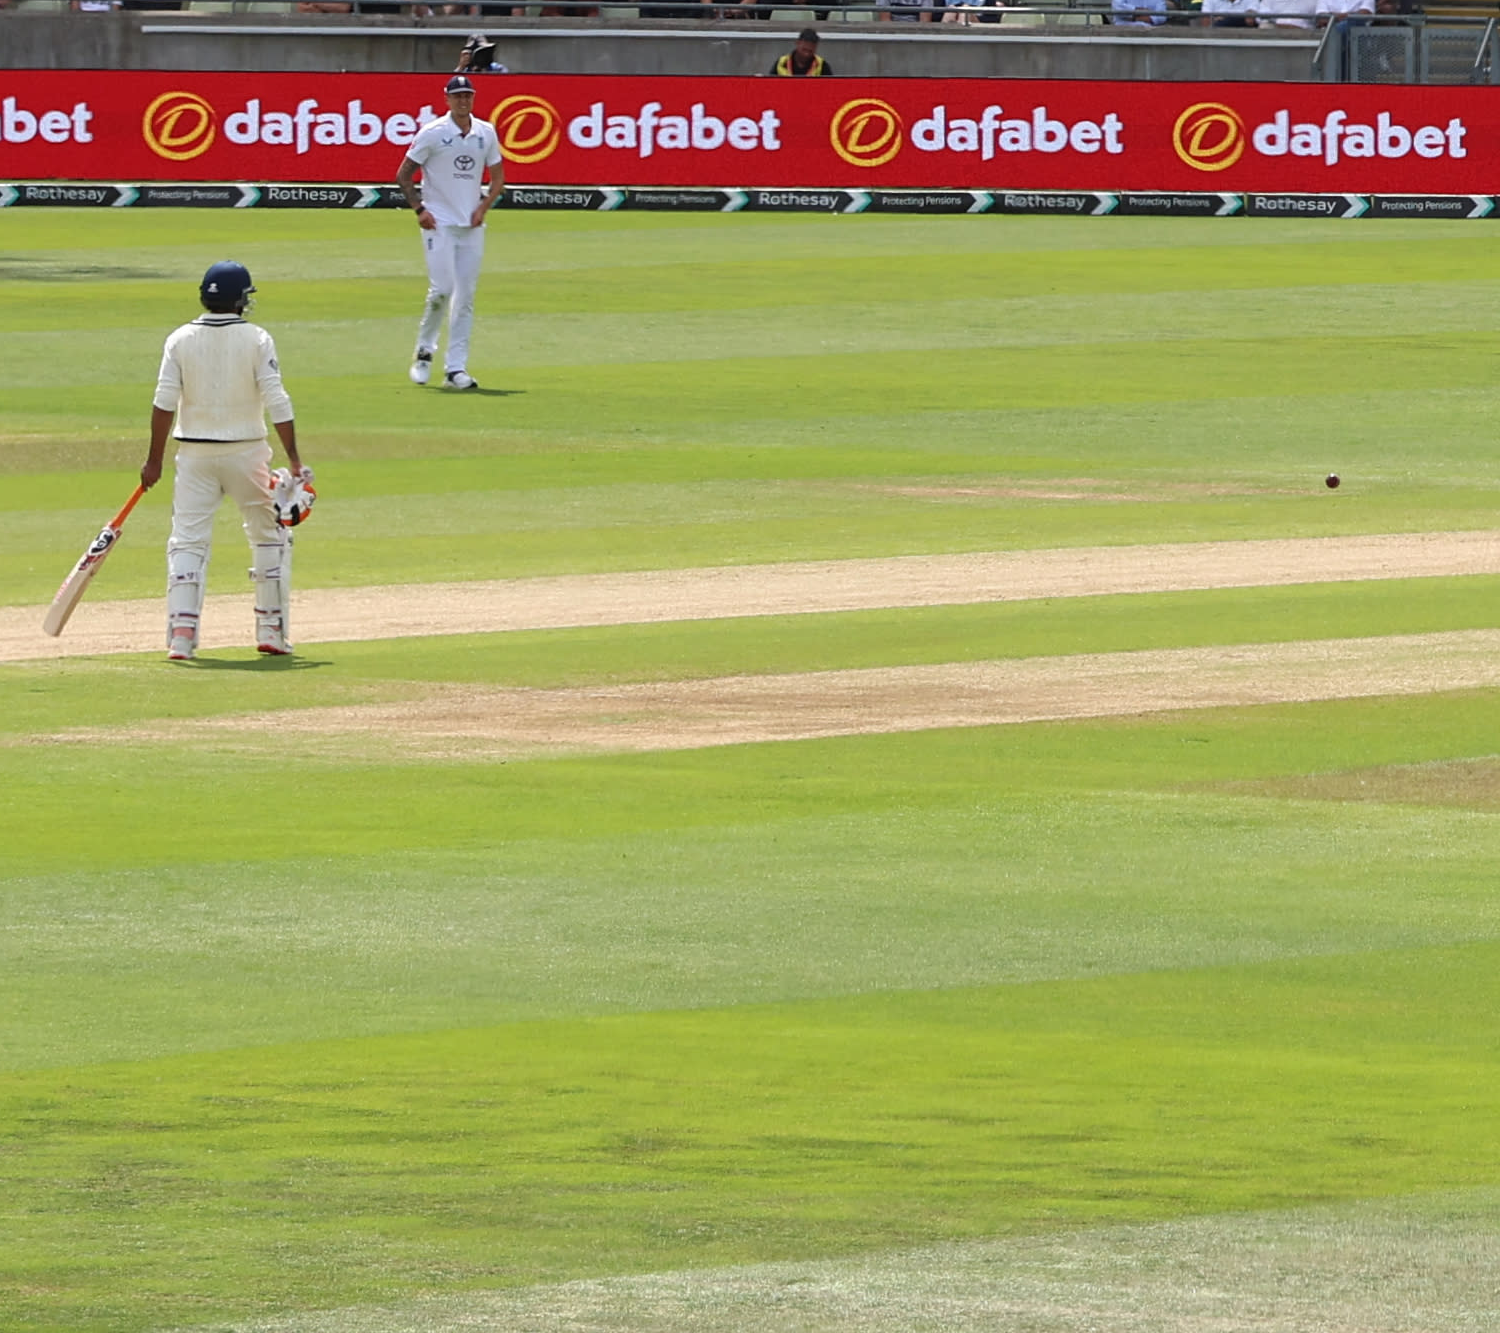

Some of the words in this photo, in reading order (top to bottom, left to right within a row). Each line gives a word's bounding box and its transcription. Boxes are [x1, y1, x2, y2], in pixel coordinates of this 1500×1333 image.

[224, 99, 437, 153] dafabet
[569, 102, 780, 157] dafabet
[911, 106, 1123, 160] dafabet
[1253, 110, 1466, 165] dafabet
[26, 187, 106, 202] Rothesay
[269, 188, 347, 203] Rothesay
[513, 190, 592, 206] Rothesay
[759, 192, 838, 208] Rothesay
[1005, 195, 1085, 210] Rothesay
[1128, 196, 1171, 208] Protecting
[1173, 197, 1211, 206] Pensions
[1256, 196, 1336, 213] Rothesay
